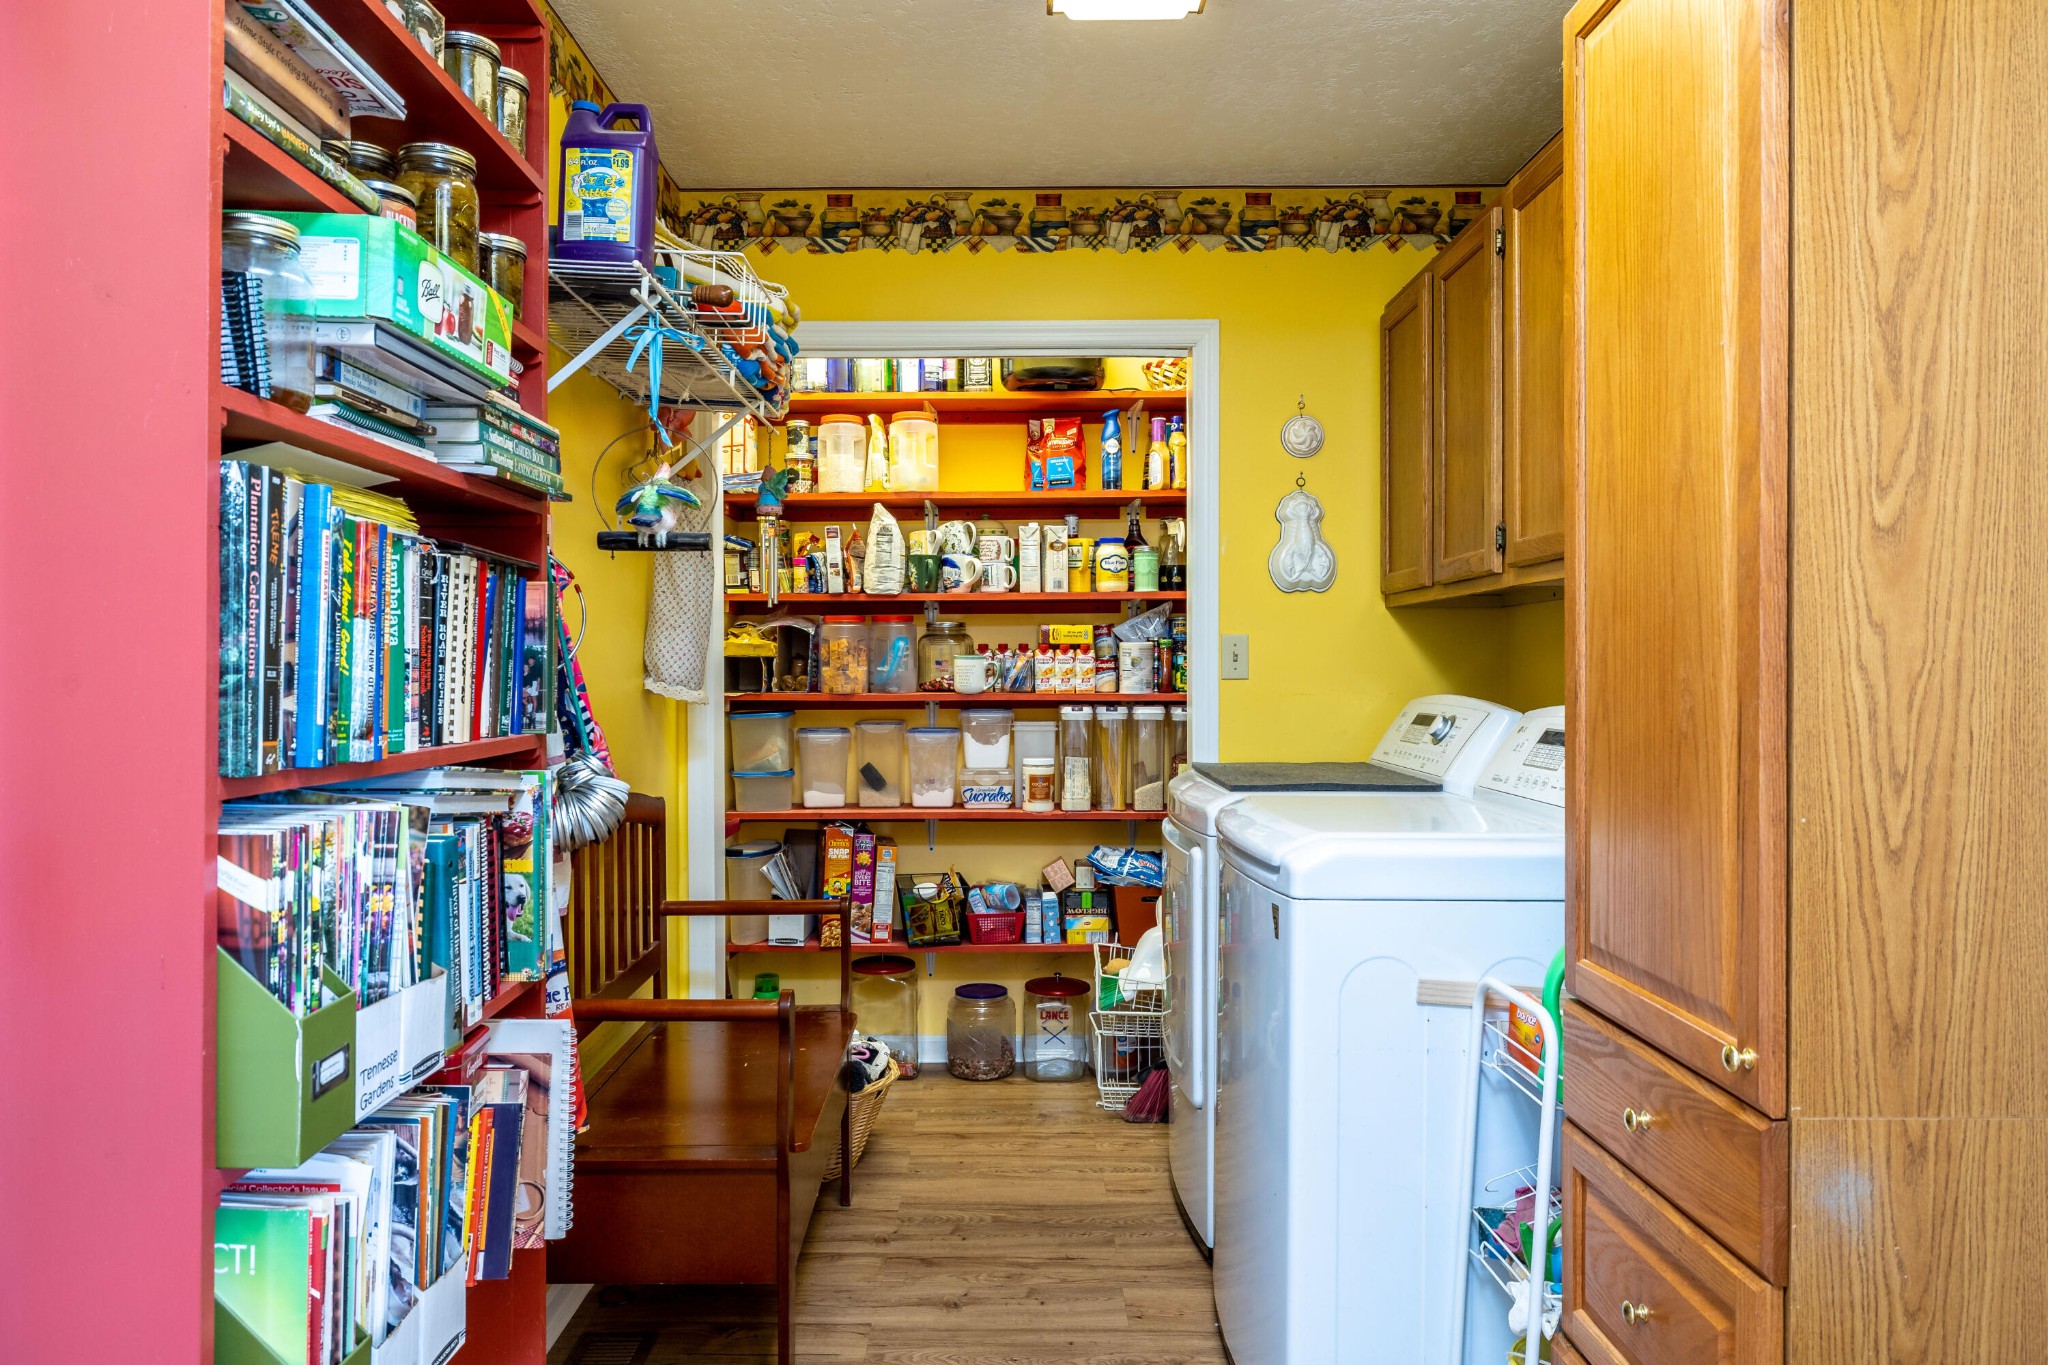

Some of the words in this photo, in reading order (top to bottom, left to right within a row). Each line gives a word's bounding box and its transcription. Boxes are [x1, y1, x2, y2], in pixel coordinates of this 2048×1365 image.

[235, 17, 257, 40] Home
[257, 36, 276, 59] Style
[275, 52, 301, 81] Cooking
[301, 71, 318, 93] Made
[318, 89, 334, 109] Easy
[280, 125, 309, 153] HARVEST
[568, 158, 579, 166] 64
[571, 172, 626, 189] Miracle
[420, 278, 441, 303] Ball
[513, 438, 531, 459] GARDEN
[531, 447, 545, 466] BOOK
[513, 458, 539, 481] LANDSCAPE
[538, 468, 552, 486] BOOK
[250, 476, 262, 565] Plantation
[269, 507, 280, 565] TREME
[343, 538, 353, 574] Talk
[341, 577, 351, 623] About
[389, 552, 401, 646] Jambalaya
[440, 574, 449, 619] RIVER
[248, 569, 260, 679] Celebrations
[369, 590, 377, 640] FLAVORS
[340, 628, 351, 676] Good!
[438, 624, 447, 659] ROAD
[419, 658, 427, 695] Notebook
[437, 665, 445, 725] RECIPES
[451, 875, 459, 916] Flavor
[453, 918, 460, 931] of
[1039, 1010, 1070, 1020] LANCE
[1516, 1007, 1537, 1027] bounce
[360, 1075, 395, 1111] Gardens
[248, 1184, 301, 1193] Collector's
[302, 1185, 329, 1193] Issue
[476, 1211, 484, 1250] Supper
